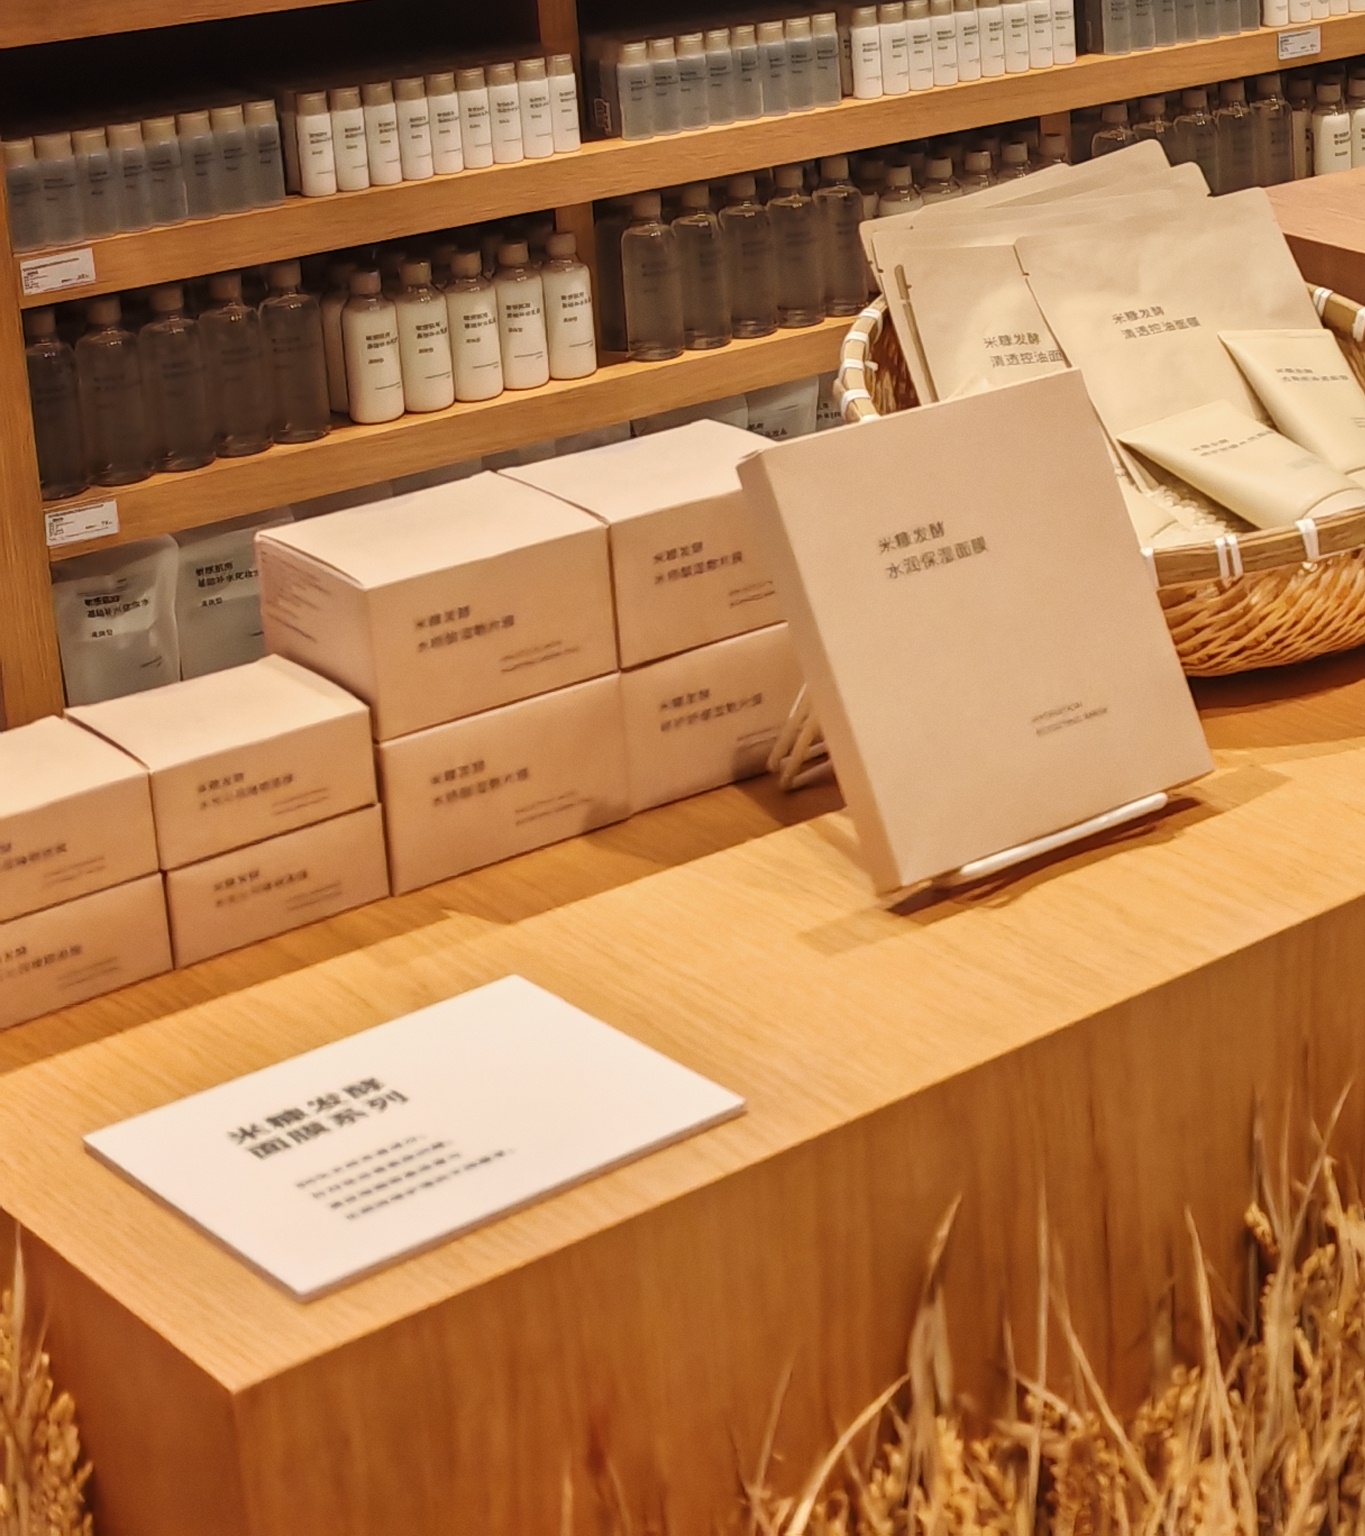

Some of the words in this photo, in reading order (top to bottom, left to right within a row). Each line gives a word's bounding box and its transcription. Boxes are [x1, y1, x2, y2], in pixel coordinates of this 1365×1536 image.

[983, 332, 1041, 349] 米糠发酵
[879, 521, 946, 555] 米糠发酵
[226, 1076, 386, 1146] 米糠发酵
